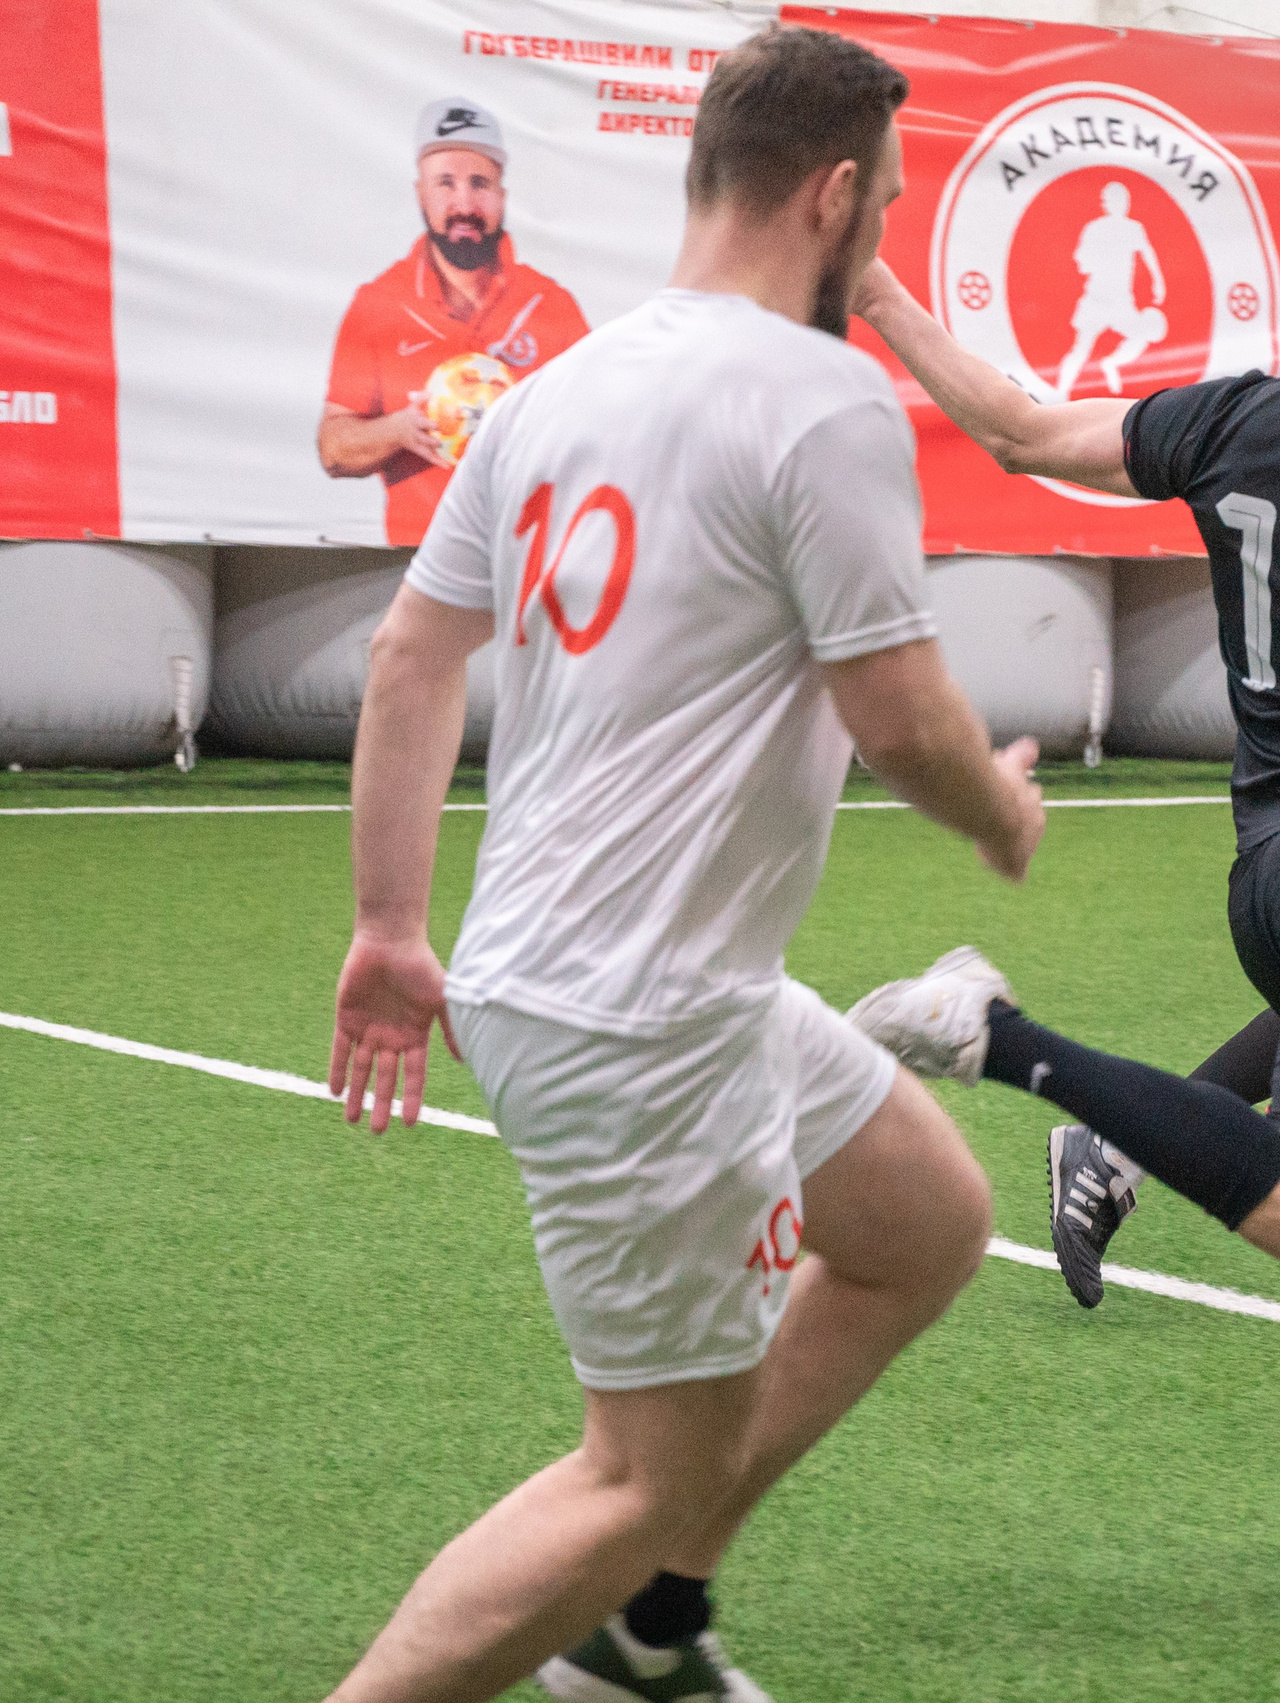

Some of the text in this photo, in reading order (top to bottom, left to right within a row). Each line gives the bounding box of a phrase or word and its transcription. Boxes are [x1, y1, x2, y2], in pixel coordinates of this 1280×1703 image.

[598, 79, 701, 106] ГЕНЕРАЛ
[597, 111, 694, 137] ДИРЕКТО
[999, 115, 1220, 202] АКАДЕМИЯ
[513, 481, 637, 657] 10
